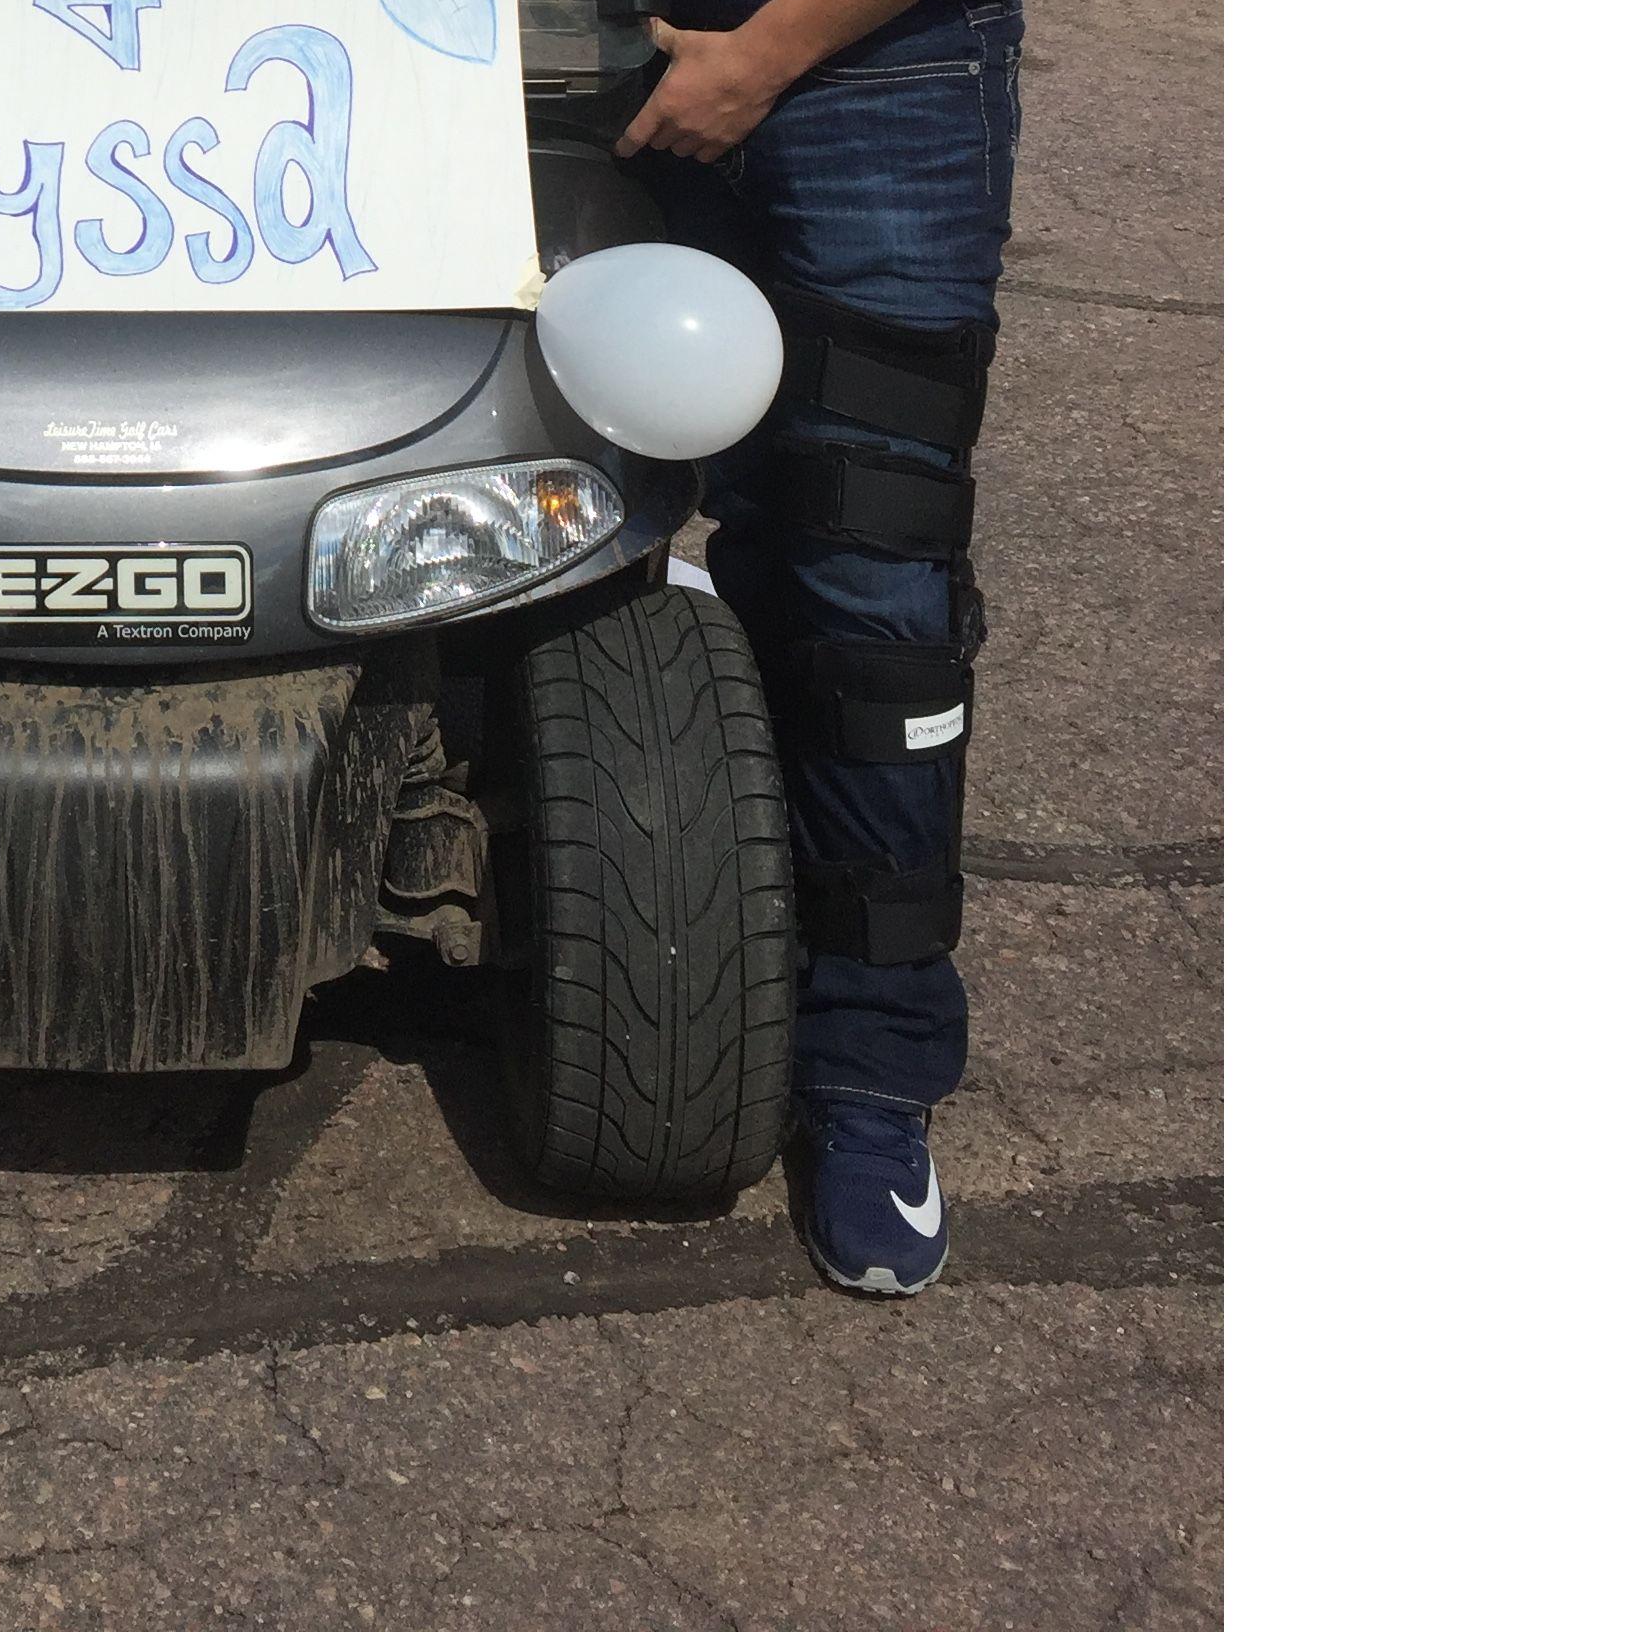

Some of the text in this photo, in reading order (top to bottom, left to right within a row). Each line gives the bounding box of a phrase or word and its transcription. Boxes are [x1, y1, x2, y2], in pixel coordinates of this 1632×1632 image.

[118, 421, 147, 441] Golf
[147, 420, 178, 441] Cars
[61, 441, 88, 451] NEW
[97, 624, 252, 642] A Textron Company
